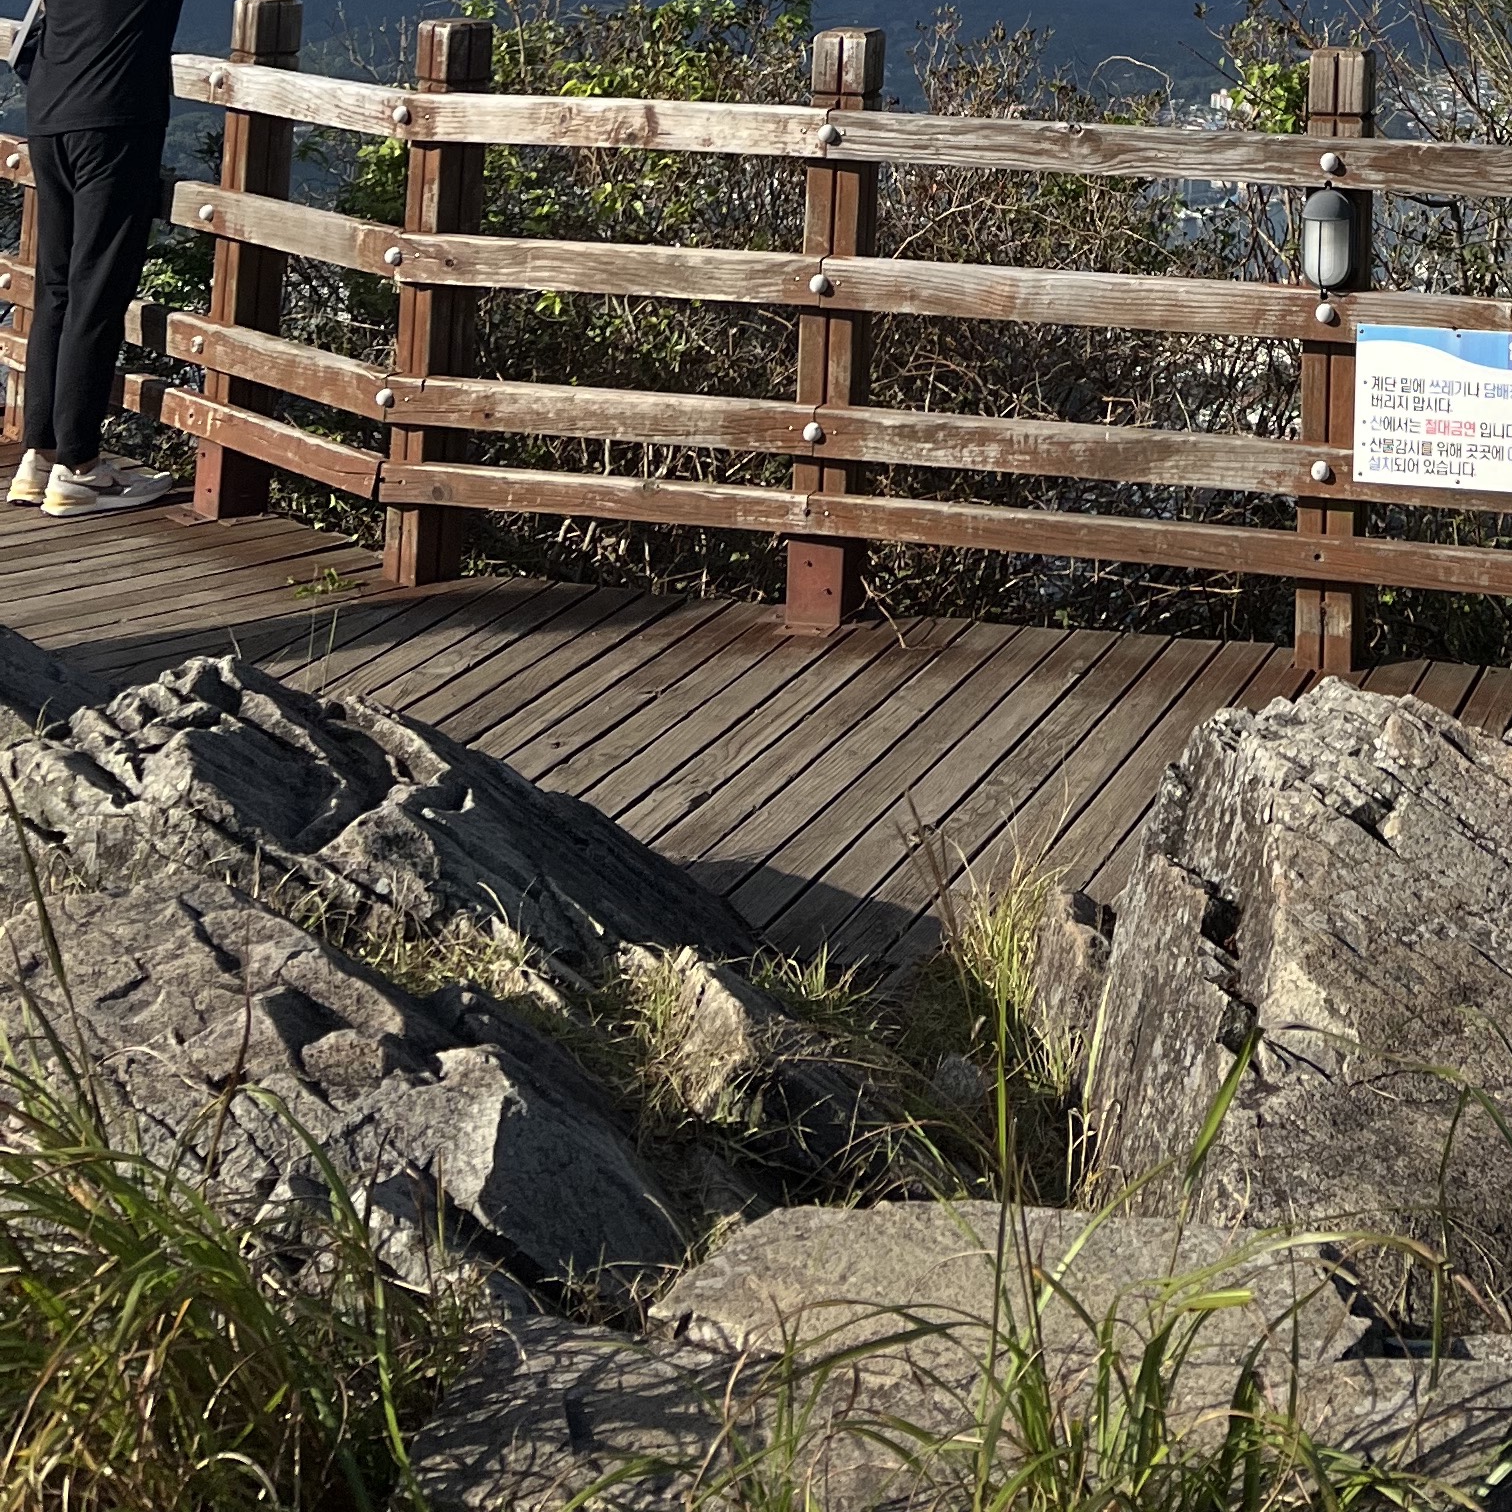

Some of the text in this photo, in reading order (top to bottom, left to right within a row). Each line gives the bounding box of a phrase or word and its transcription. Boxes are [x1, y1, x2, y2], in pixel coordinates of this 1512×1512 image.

[1371, 375, 1396, 392] 계단
[1400, 376, 1425, 394] 밑에
[1429, 379, 1480, 397] 쓰레기나
[1371, 393, 1408, 411] 버리지
[1370, 415, 1421, 433] 산에서는
[1425, 418, 1476, 438] 절대금연
[1370, 437, 1432, 457] 산불감시를
[1437, 441, 1462, 459] 위해
[1466, 443, 1504, 461] 곳곳에
[1369, 456, 1419, 474] 설치되어
